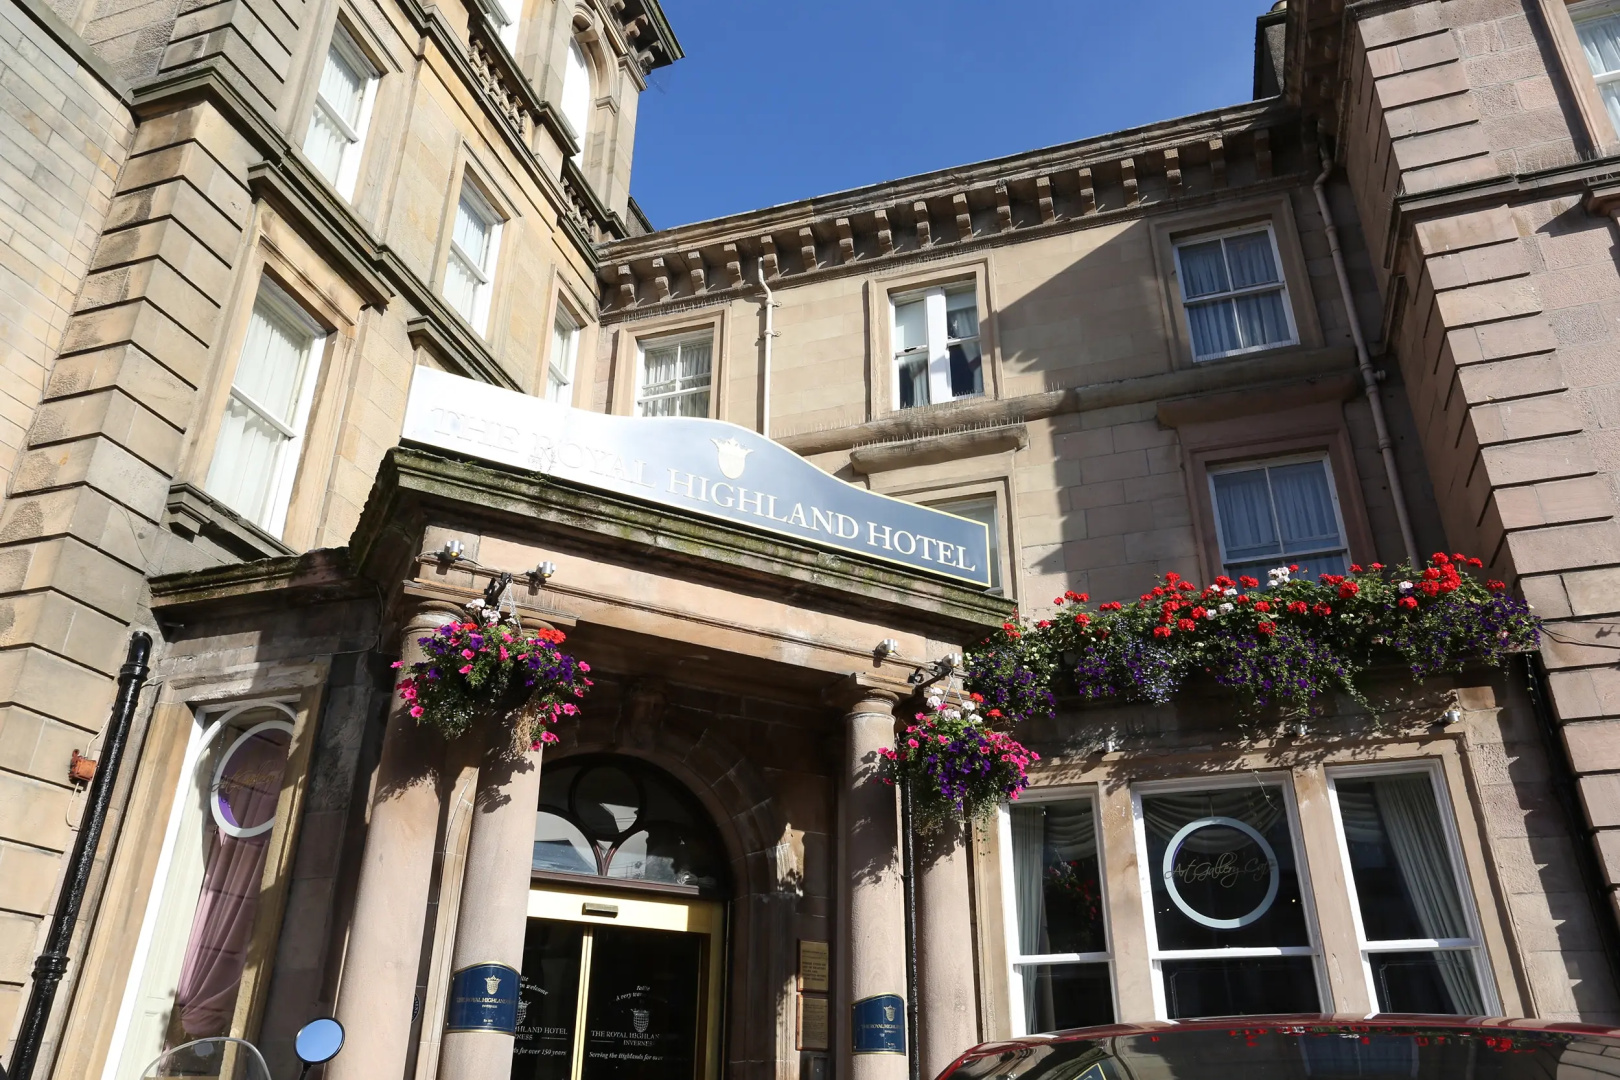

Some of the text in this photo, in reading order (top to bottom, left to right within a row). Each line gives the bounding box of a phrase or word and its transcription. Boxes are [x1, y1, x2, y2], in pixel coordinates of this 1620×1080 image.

[430, 407, 977, 572] THE ROYAL HIGHLAND HOTEL
[1165, 859, 1197, 883] Art
[1194, 851, 1244, 888] Gallery
[526, 984, 549, 996] welcome
[515, 1026, 568, 1035] HLAND HOTEL
[590, 1030, 605, 1038] THE
[606, 1031, 628, 1039] ROYAL
[629, 1032, 660, 1040] HIGHLAN
[623, 1039, 656, 1047] INVERNES
[518, 1047, 528, 1055] for
[589, 1052, 608, 1060] Serving
